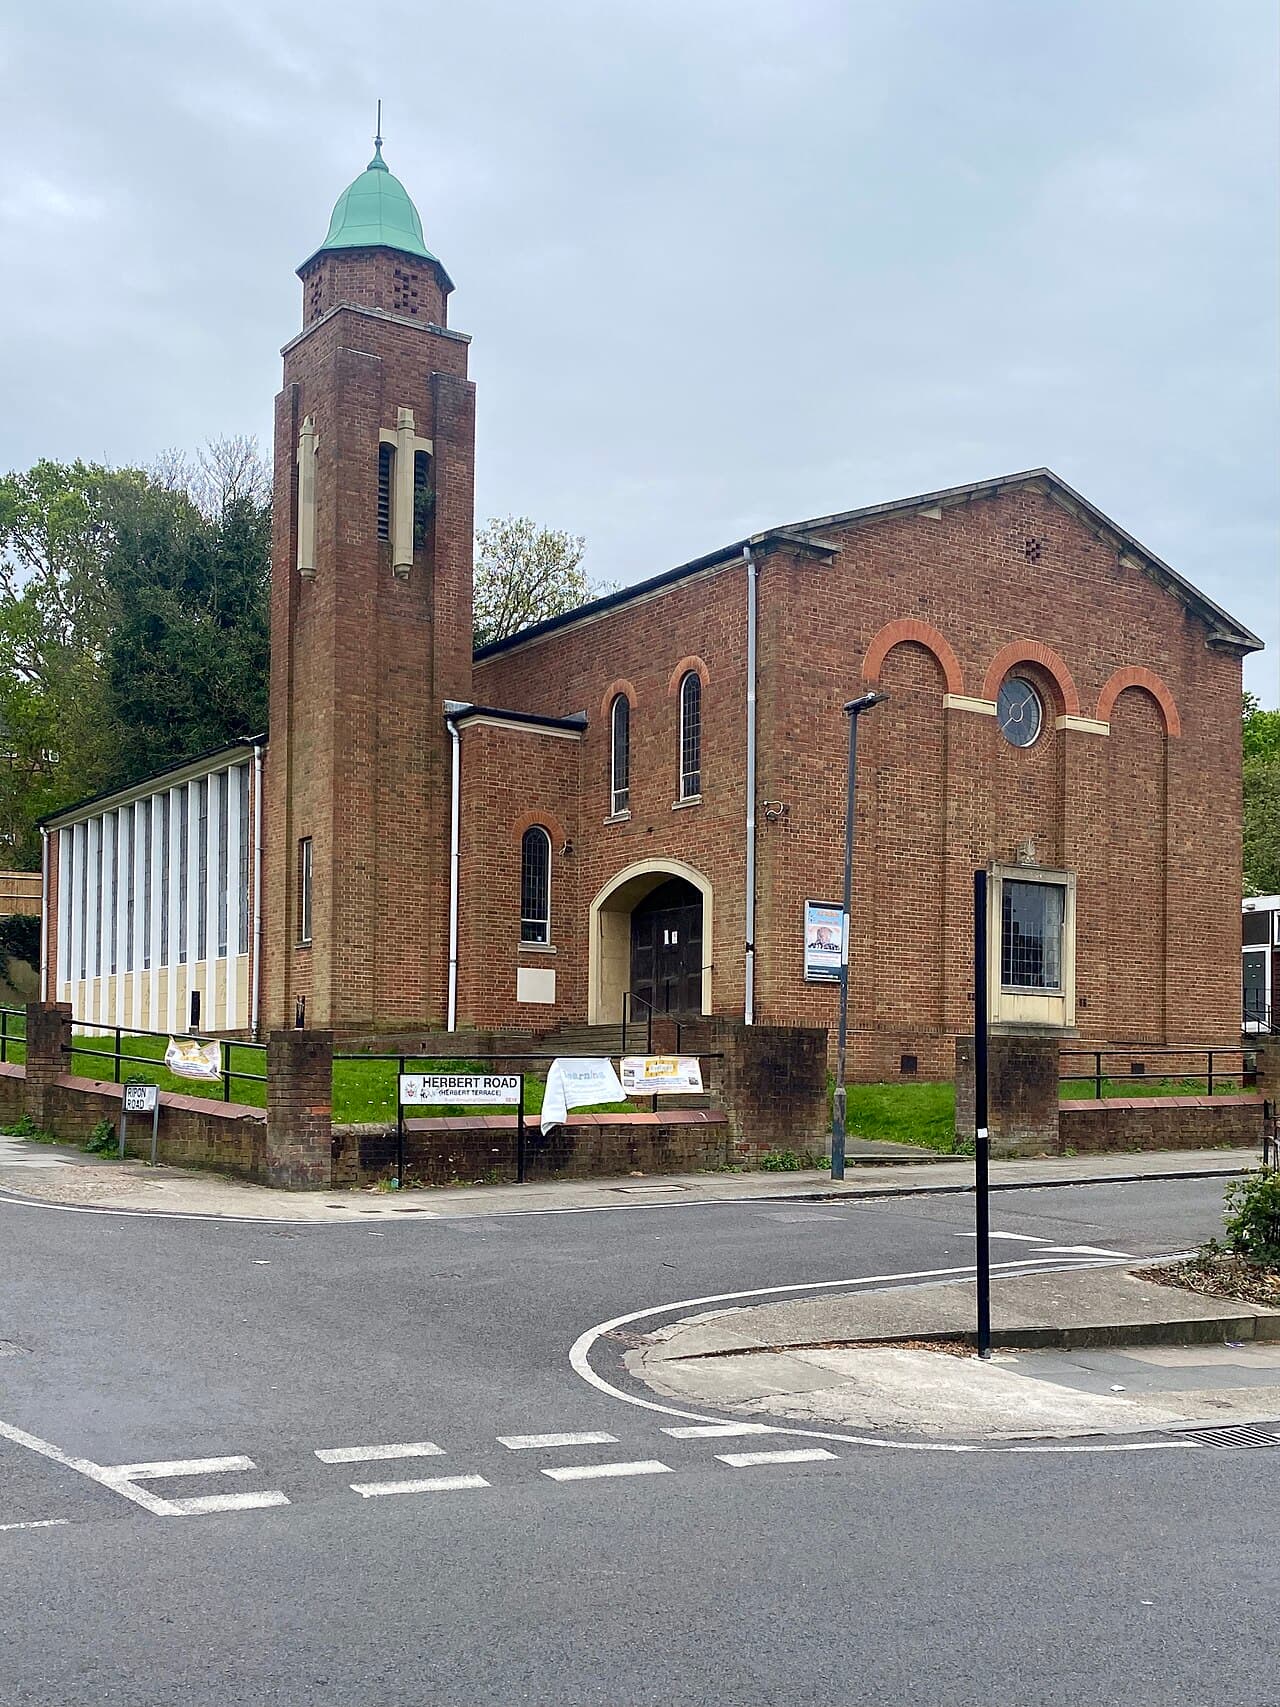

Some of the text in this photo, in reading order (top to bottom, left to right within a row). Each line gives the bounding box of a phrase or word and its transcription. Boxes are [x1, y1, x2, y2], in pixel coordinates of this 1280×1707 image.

[423, 1077, 517, 1088] HERBERT ROAD
[127, 1087, 146, 1098] RIPON
[438, 1089, 502, 1097] (HERBERT TERRACE)
[127, 1099, 145, 1109] ROAD
